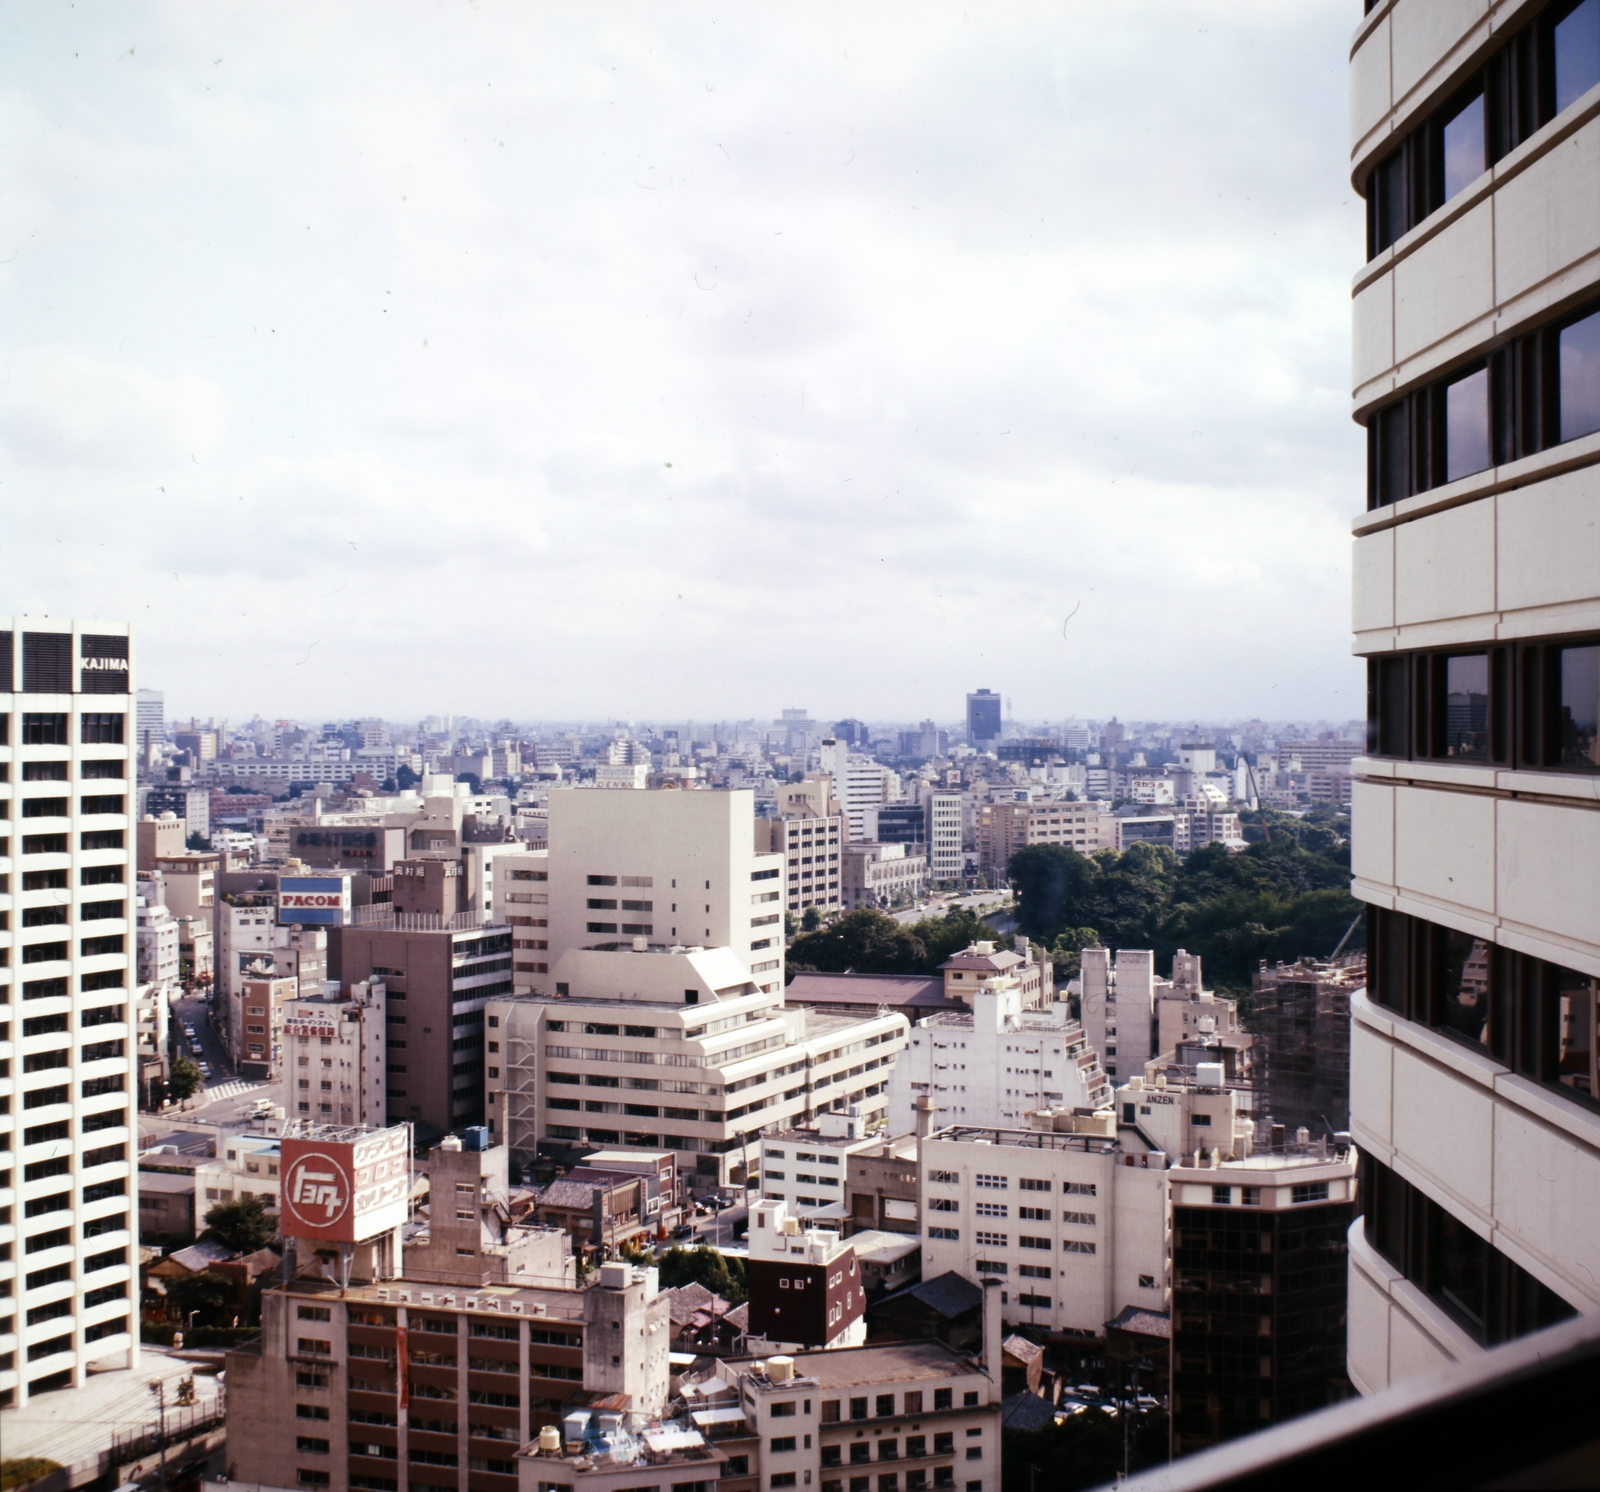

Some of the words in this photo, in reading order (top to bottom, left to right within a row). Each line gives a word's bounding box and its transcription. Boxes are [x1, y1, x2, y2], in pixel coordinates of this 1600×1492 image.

[81, 657, 128, 670] KAJIMA
[282, 895, 340, 906] FACOM
[1146, 1095, 1174, 1105] ANZEN
